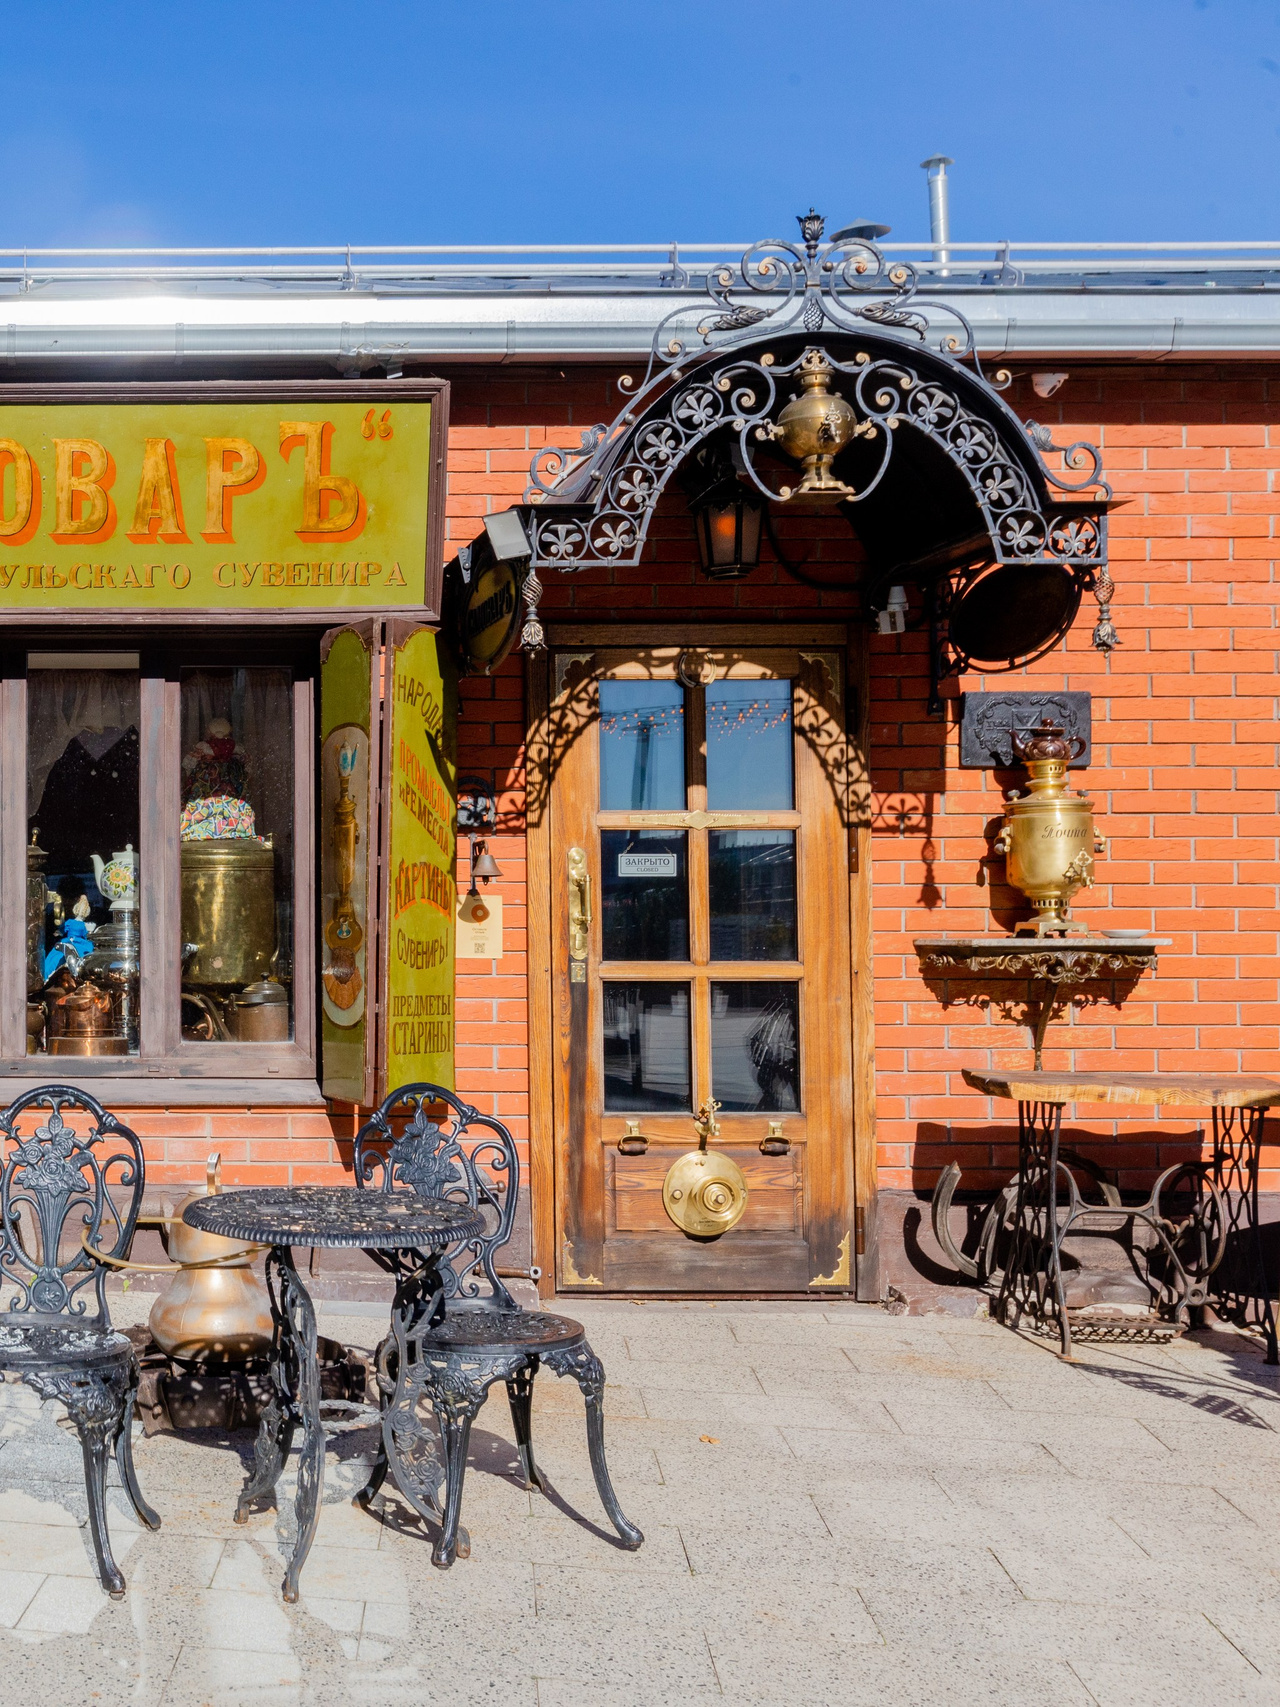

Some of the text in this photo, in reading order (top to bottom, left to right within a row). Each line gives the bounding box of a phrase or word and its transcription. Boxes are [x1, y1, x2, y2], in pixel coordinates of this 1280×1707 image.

[213, 560, 407, 588] СУВЕНИРА
[399, 737, 451, 828] ПРОМЫСЛЫ
[625, 858, 670, 866] ЗАКРЫТО
[394, 857, 453, 924] КАРТИНЫ
[397, 927, 449, 970] СУВЕНИРЫ
[393, 994, 451, 1018] ПРЕДМЕТЫ
[393, 1021, 451, 1056] СТАРИНЫ
